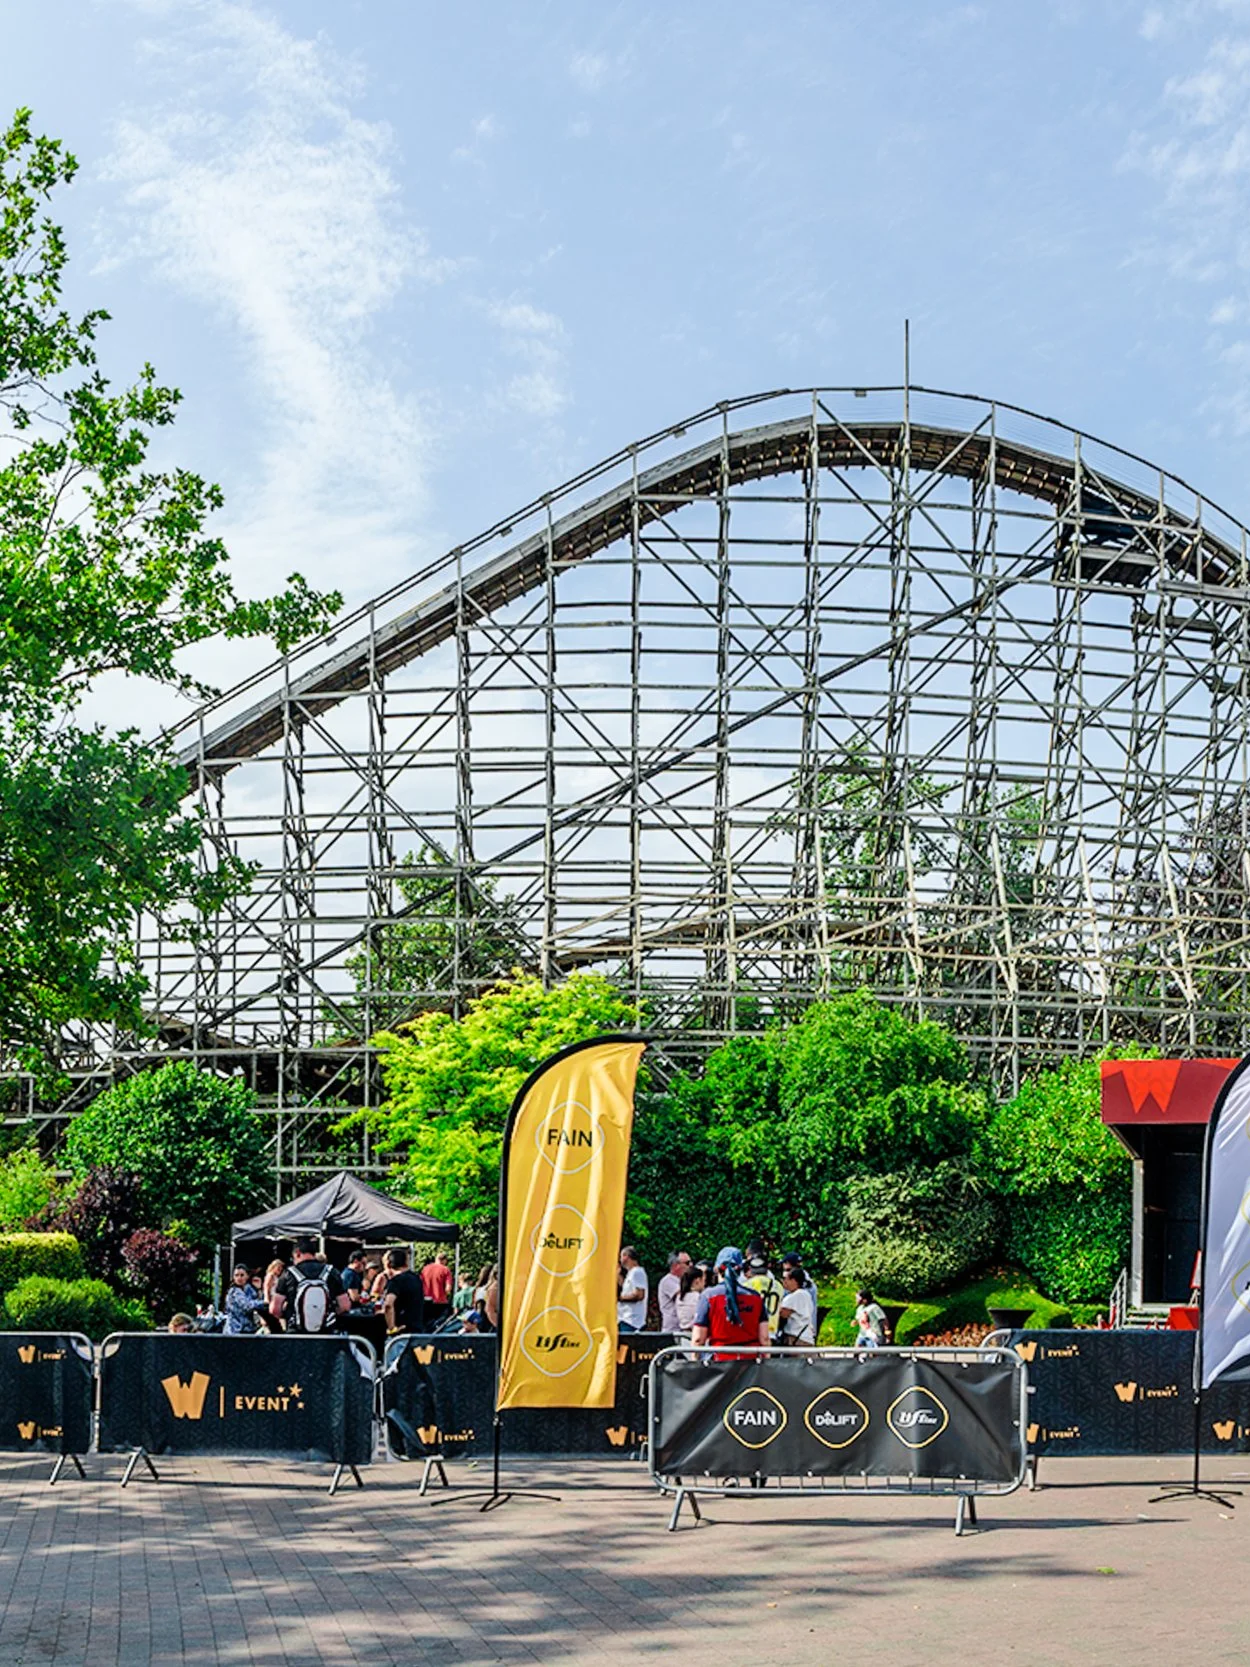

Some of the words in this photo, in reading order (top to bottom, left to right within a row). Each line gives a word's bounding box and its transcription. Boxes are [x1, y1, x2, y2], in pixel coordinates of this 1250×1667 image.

[547, 1129, 593, 1147] FAIN
[235, 1396, 289, 1411] EVENT
[734, 1410, 777, 1426] FAIN
